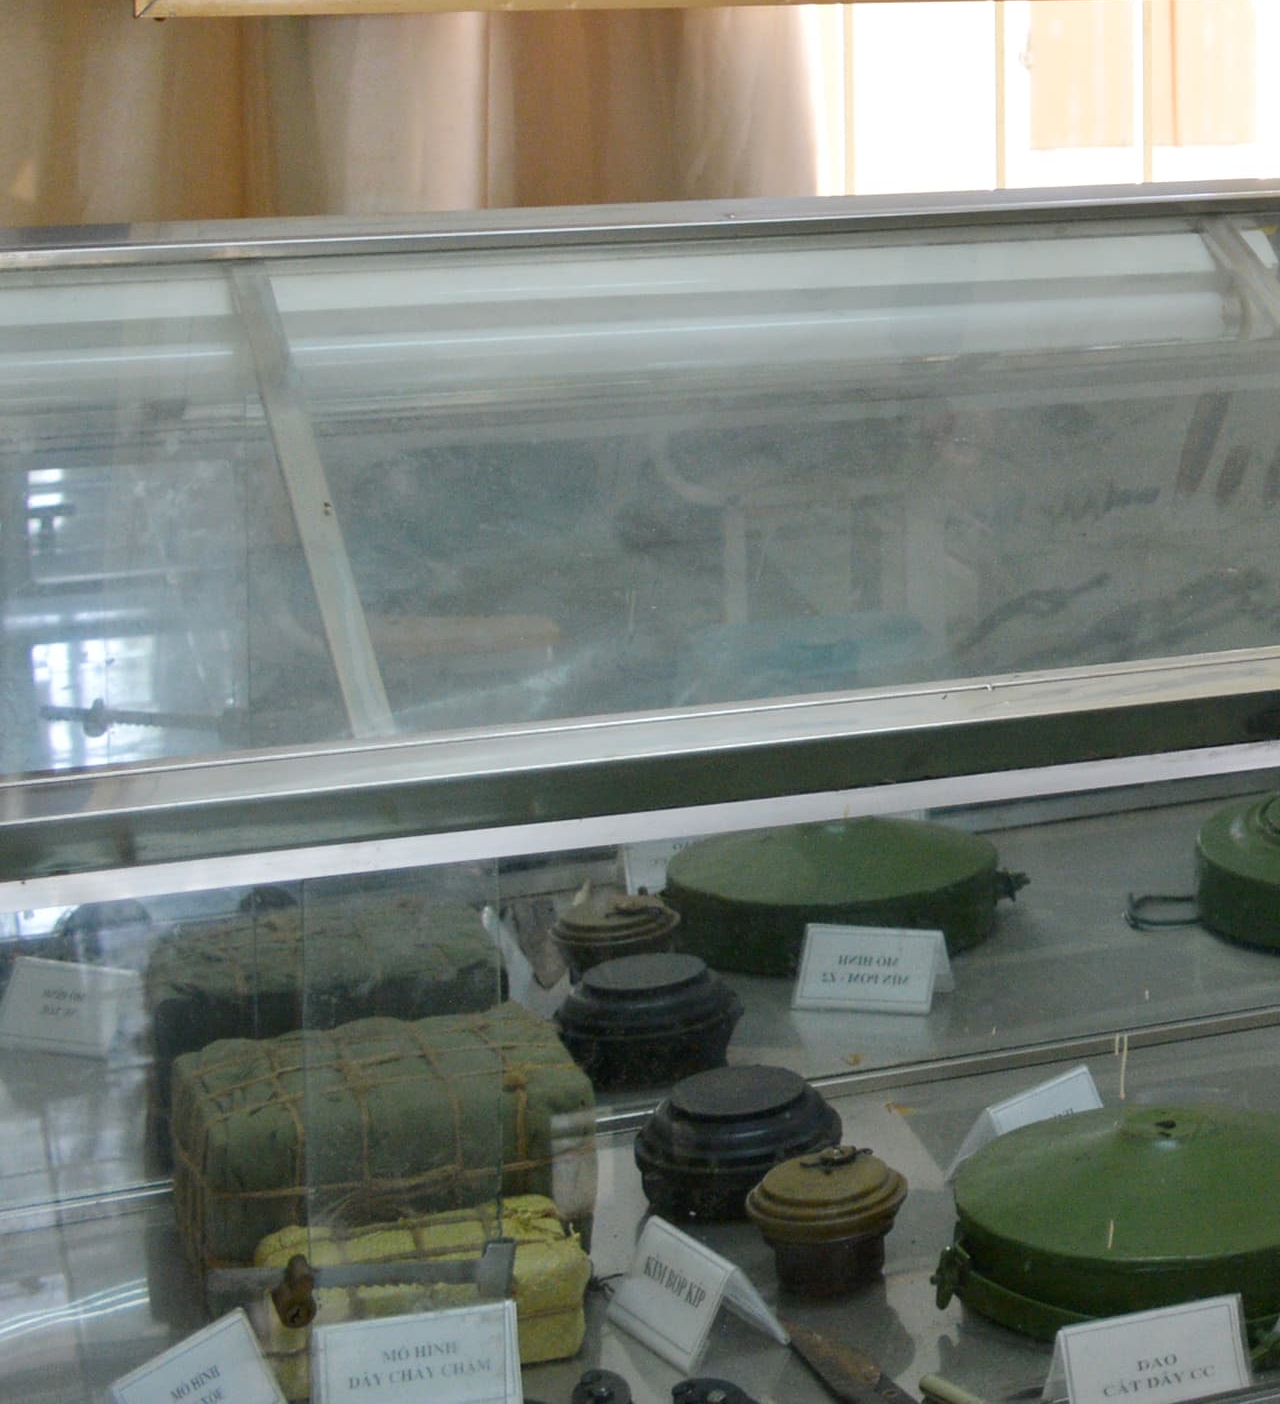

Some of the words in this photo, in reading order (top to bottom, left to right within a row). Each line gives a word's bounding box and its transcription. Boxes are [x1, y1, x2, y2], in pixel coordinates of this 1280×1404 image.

[643, 1252, 668, 1285] KÌM
[684, 1280, 707, 1309] KÍP
[382, 1346, 410, 1364] MÔ
[414, 1340, 457, 1359] HÌNH
[1137, 1353, 1178, 1372] DAO
[348, 1370, 382, 1389] DÂY
[388, 1364, 433, 1384] CHÁY
[1146, 1369, 1185, 1390] DÂY
